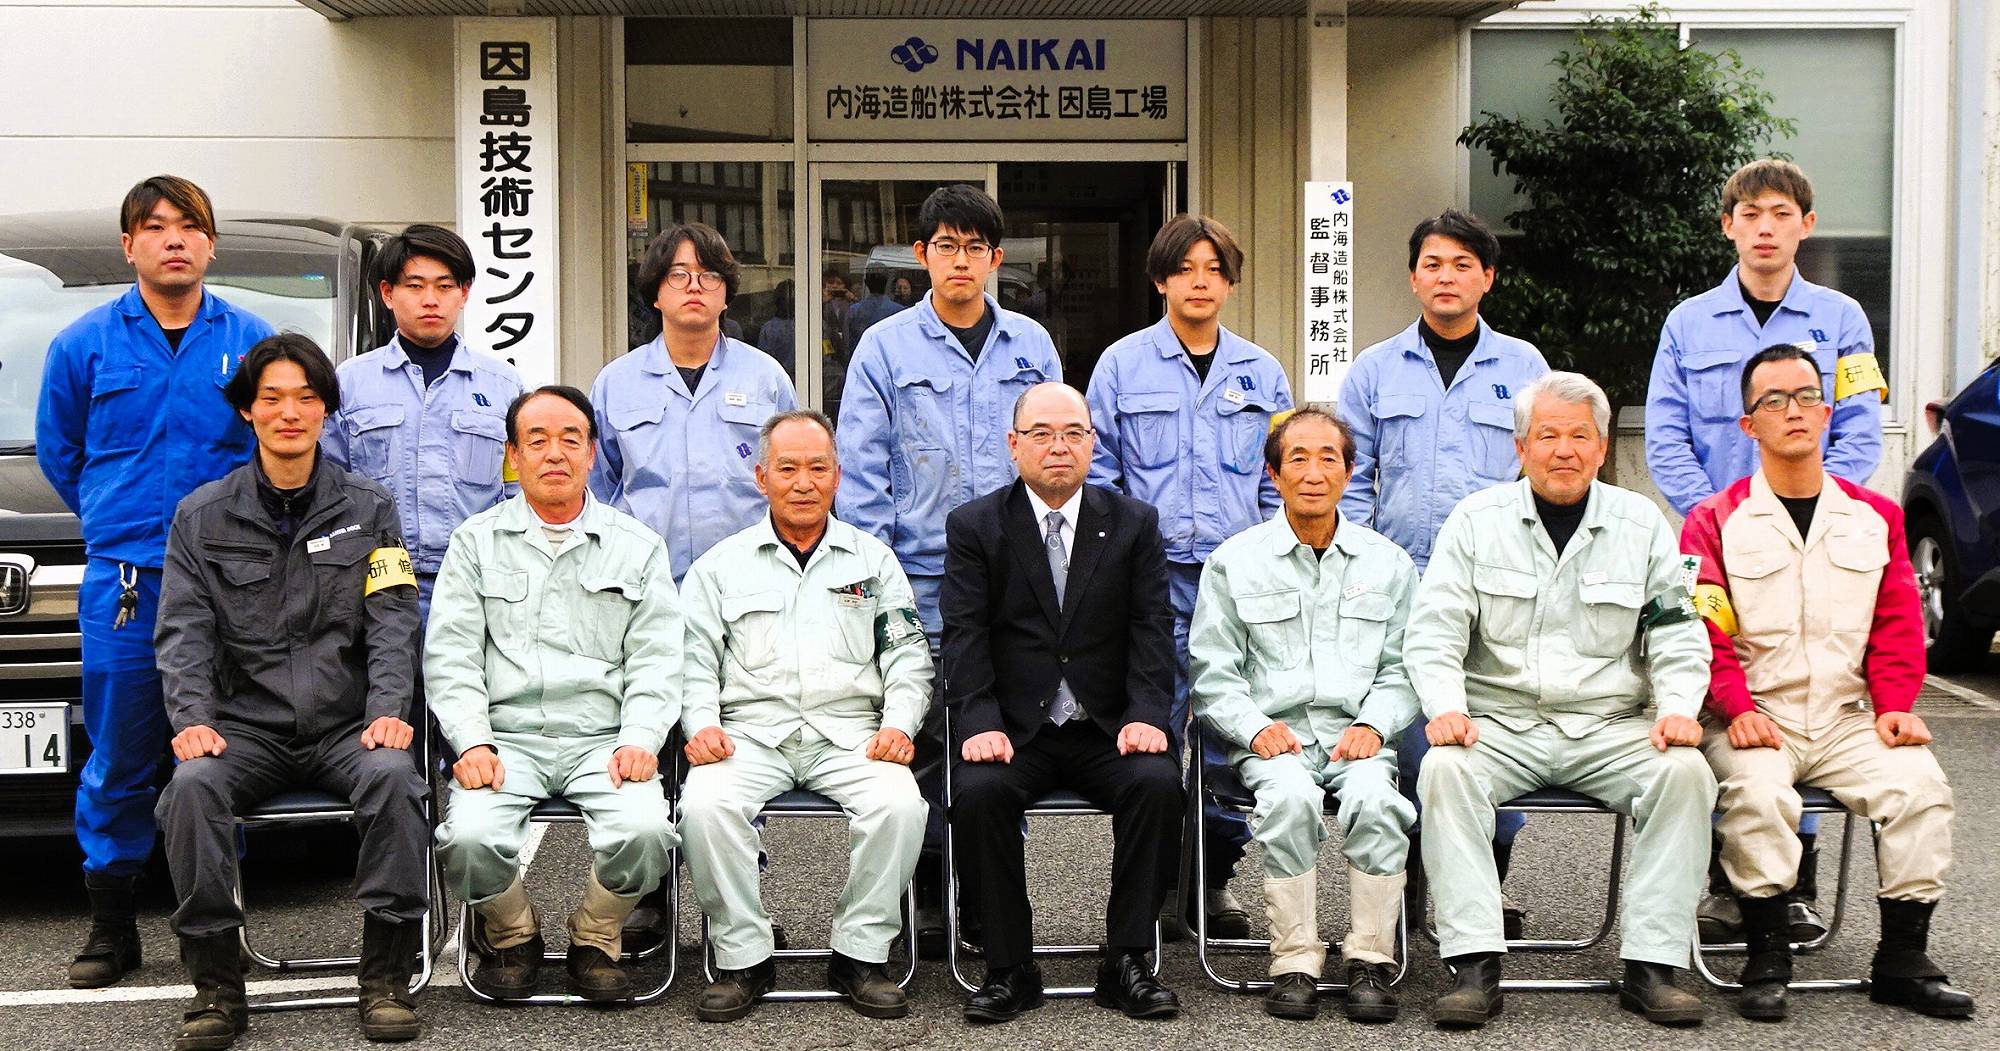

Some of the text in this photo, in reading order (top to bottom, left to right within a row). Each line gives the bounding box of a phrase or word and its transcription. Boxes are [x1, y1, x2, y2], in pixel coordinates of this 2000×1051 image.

[956, 38, 1105, 71] NAIKAI
[826, 84, 1168, 120] 内海造船株式会社 因島工場
[479, 41, 534, 366] 因島技術センタ
[1310, 217, 1330, 376] 監督事務所
[1333, 211, 1348, 363] 内海造船株式会社
[2, 711, 36, 729] 338
[25, 733, 61, 768] 14
